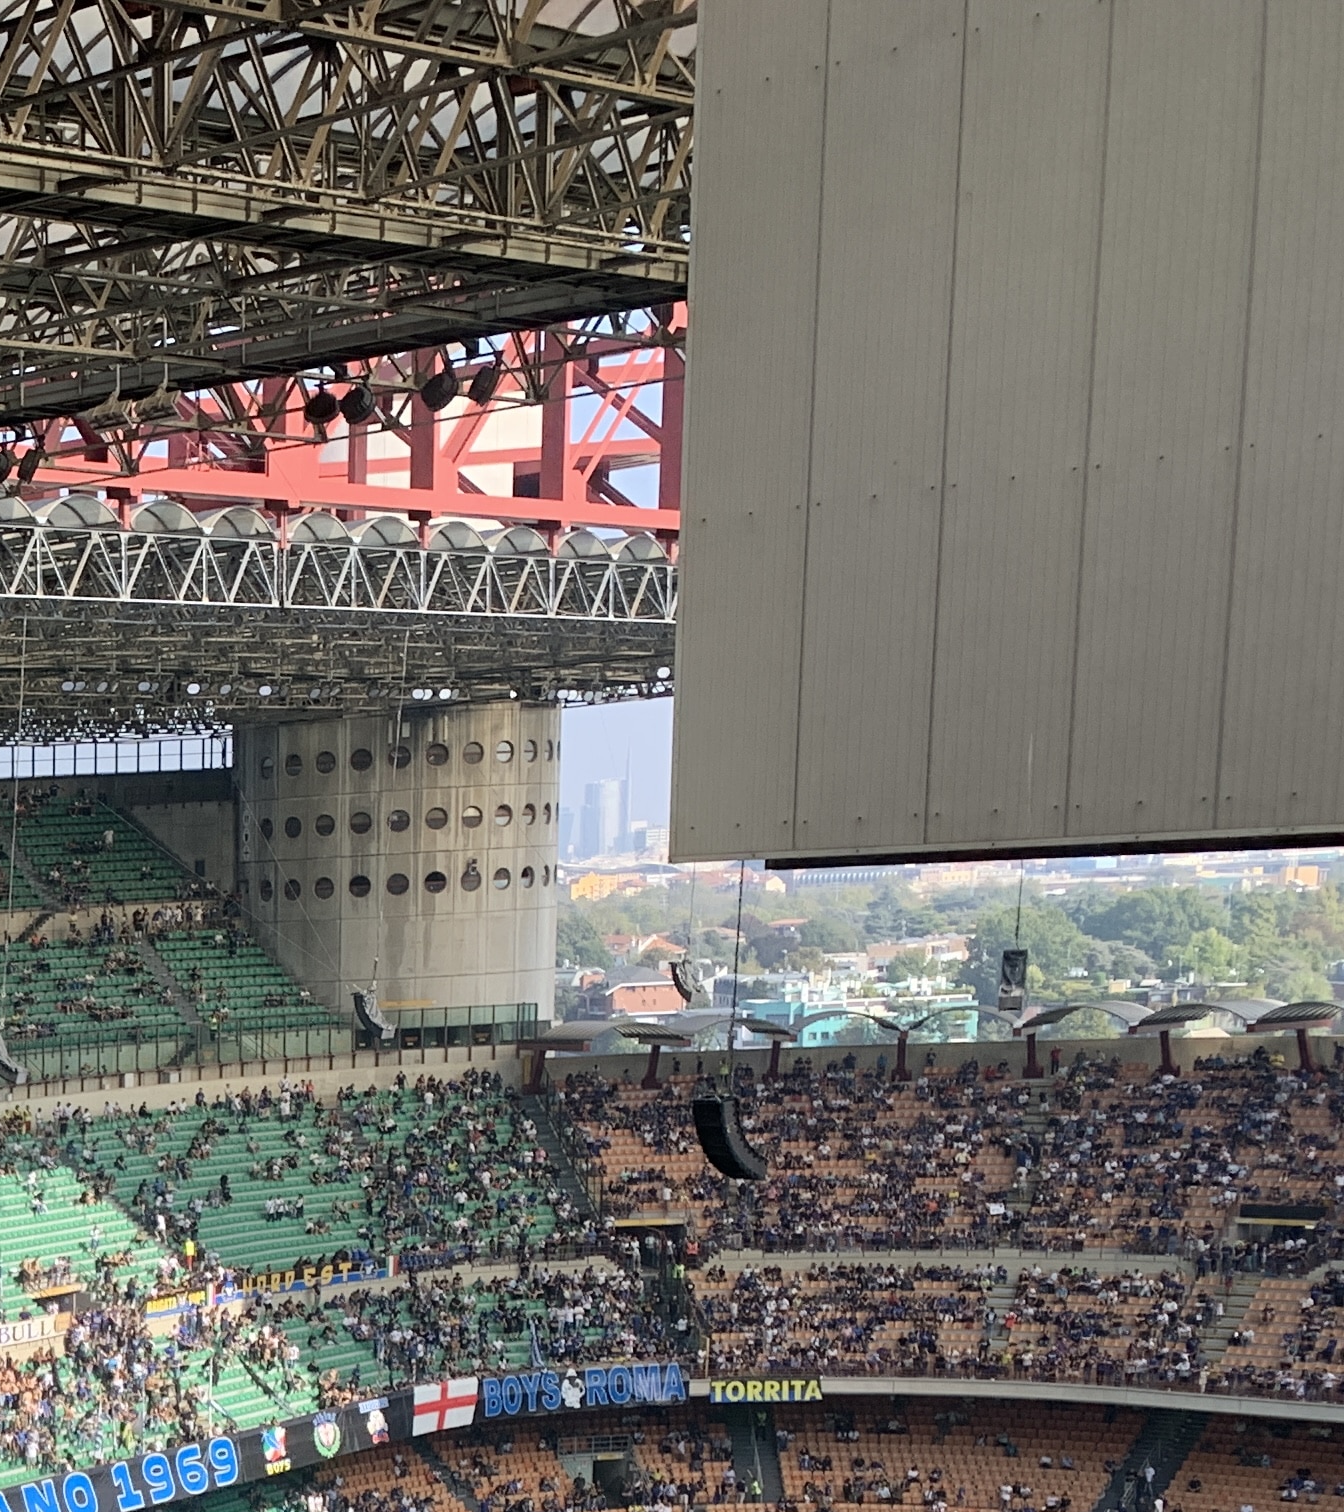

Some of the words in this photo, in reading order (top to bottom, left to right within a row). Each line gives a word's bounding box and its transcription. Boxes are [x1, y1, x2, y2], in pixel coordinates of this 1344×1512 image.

[303, 1263, 352, 1288] EST
[483, 1371, 561, 1418] BOYS
[584, 1362, 688, 1407] ROMA
[710, 1379, 823, 1402] TORRITA
[111, 1436, 240, 1512] 1969
[264, 1458, 292, 1475] BOYS
